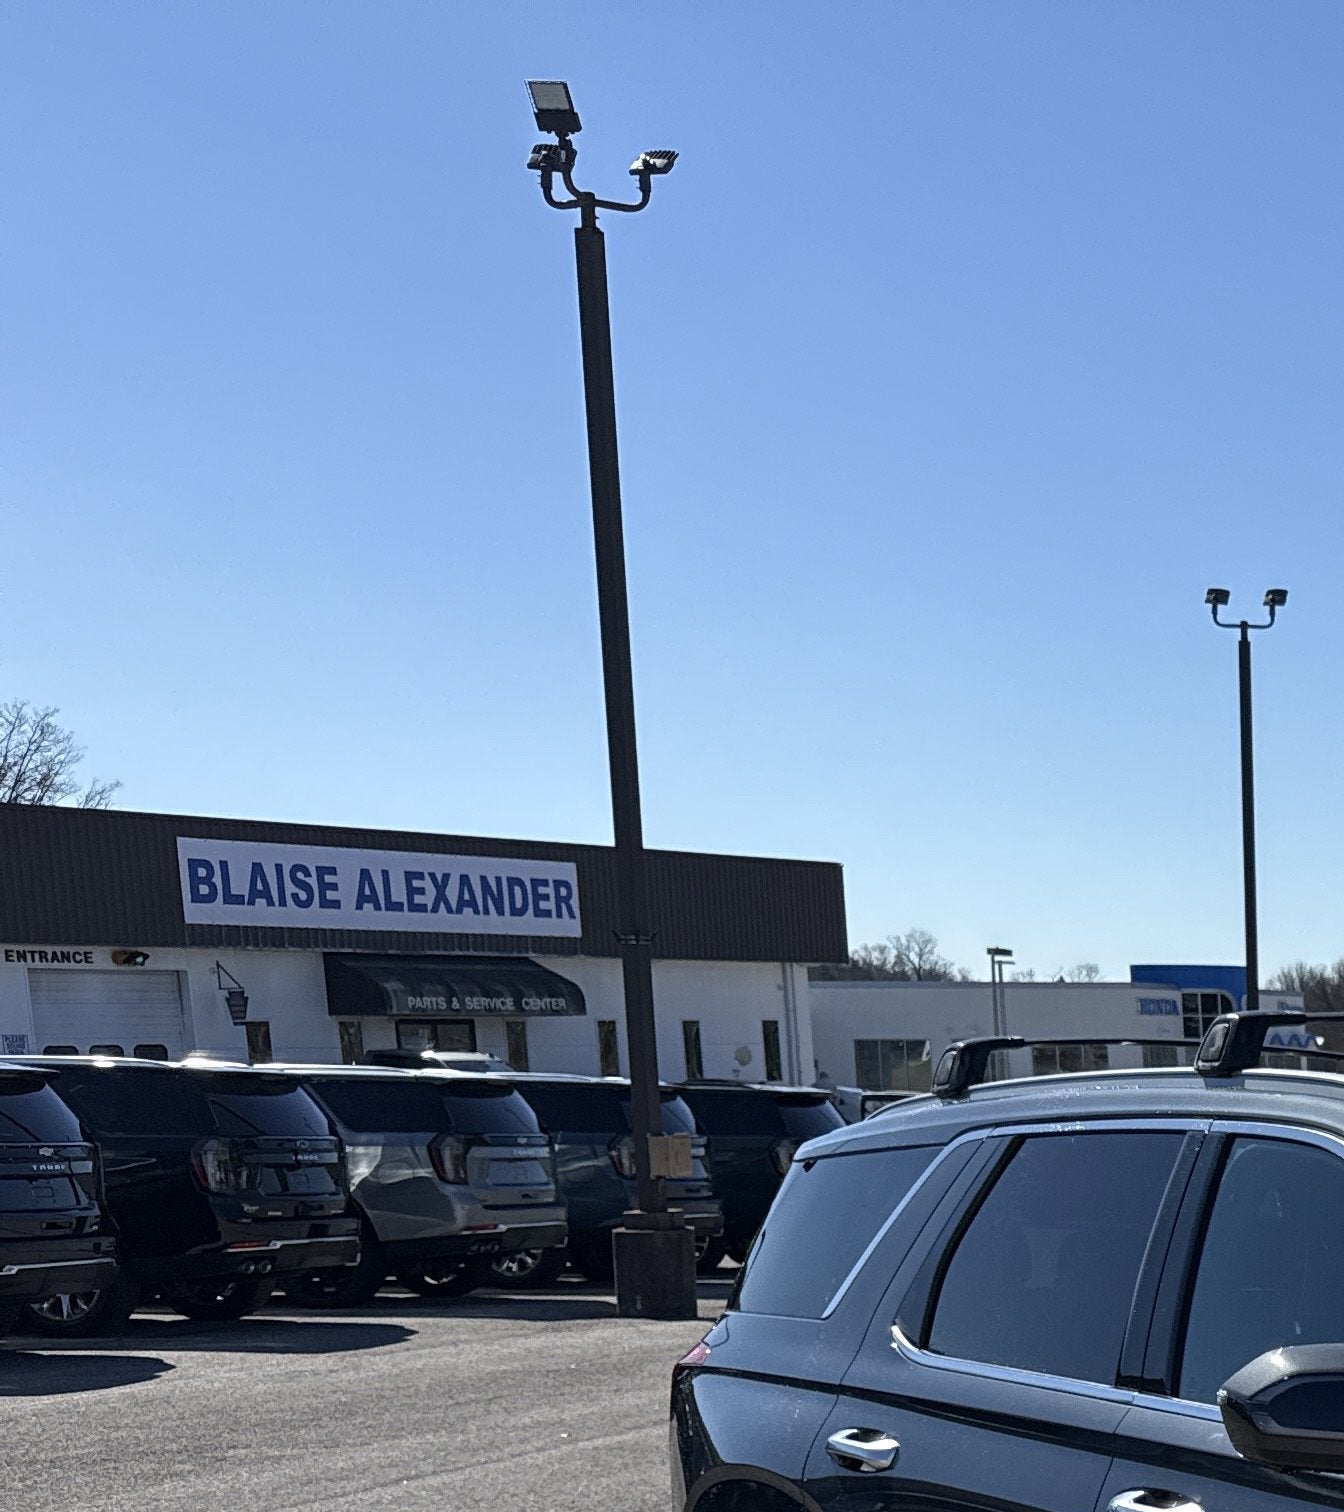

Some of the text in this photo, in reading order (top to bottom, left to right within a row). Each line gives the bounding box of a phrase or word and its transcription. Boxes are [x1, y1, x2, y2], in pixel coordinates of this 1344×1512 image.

[186, 857, 577, 920] BLAISE ALEXANDER
[4, 949, 94, 964] ENTRANCE
[407, 996, 567, 1011] PARTS & SERVICE CENTER
